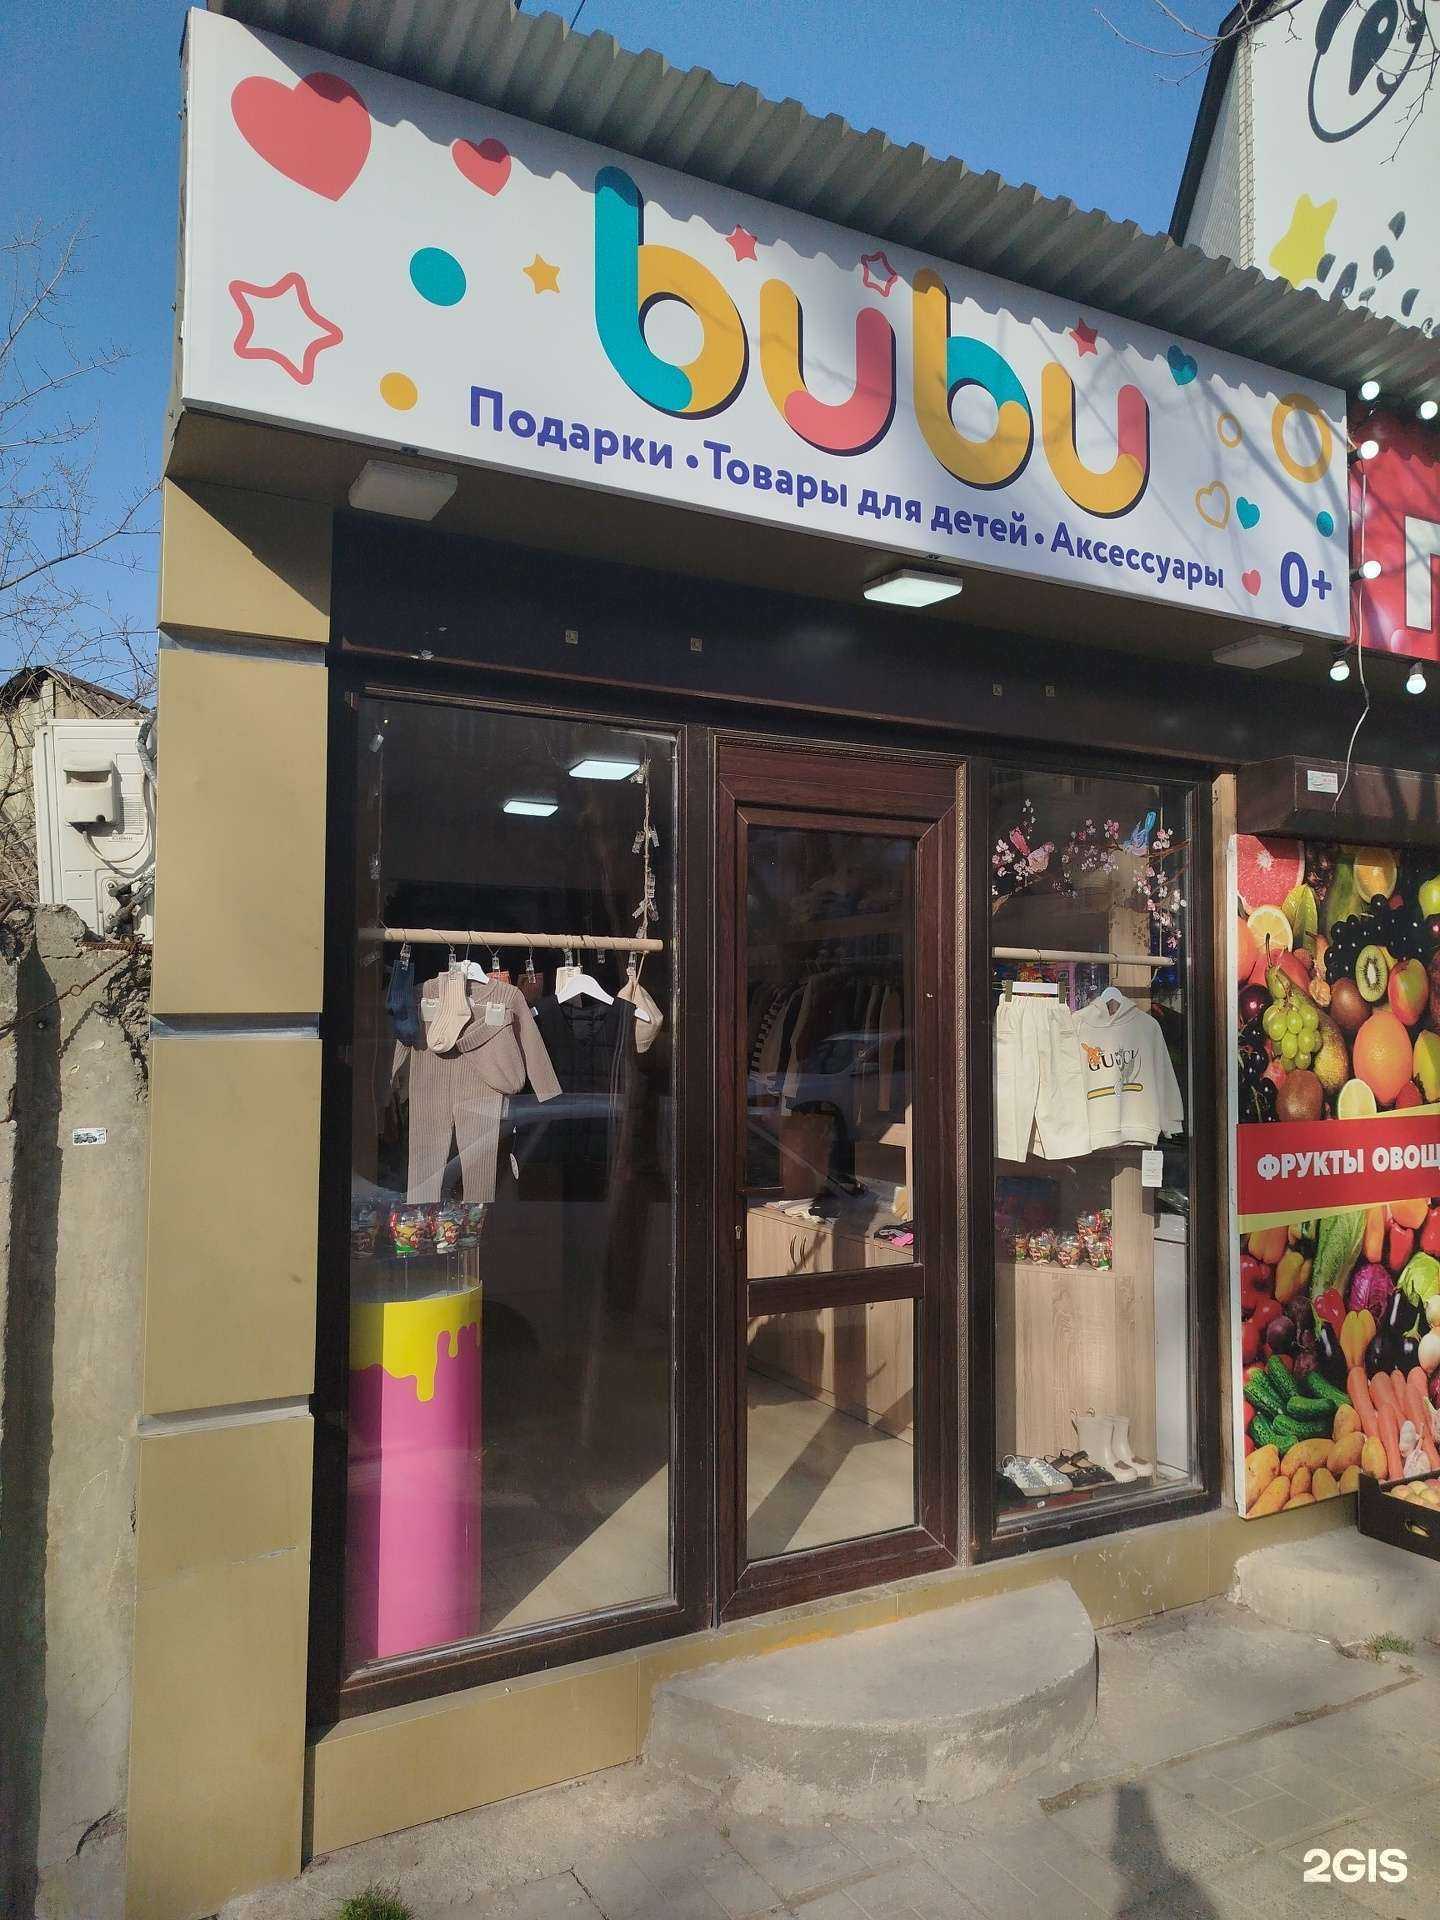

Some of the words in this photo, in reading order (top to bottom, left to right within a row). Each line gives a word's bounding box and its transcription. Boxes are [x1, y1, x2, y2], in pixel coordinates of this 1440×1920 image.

[595, 166, 1150, 519] bubu
[470, 385, 673, 465] Подарки
[704, 441, 848, 508] Товары
[858, 489, 923, 524] для
[930, 505, 1028, 547] детей
[1050, 522, 1225, 589] Аксессуары
[1280, 551, 1333, 608] 0+
[1257, 1148, 1364, 1180] ФРУКТЫ
